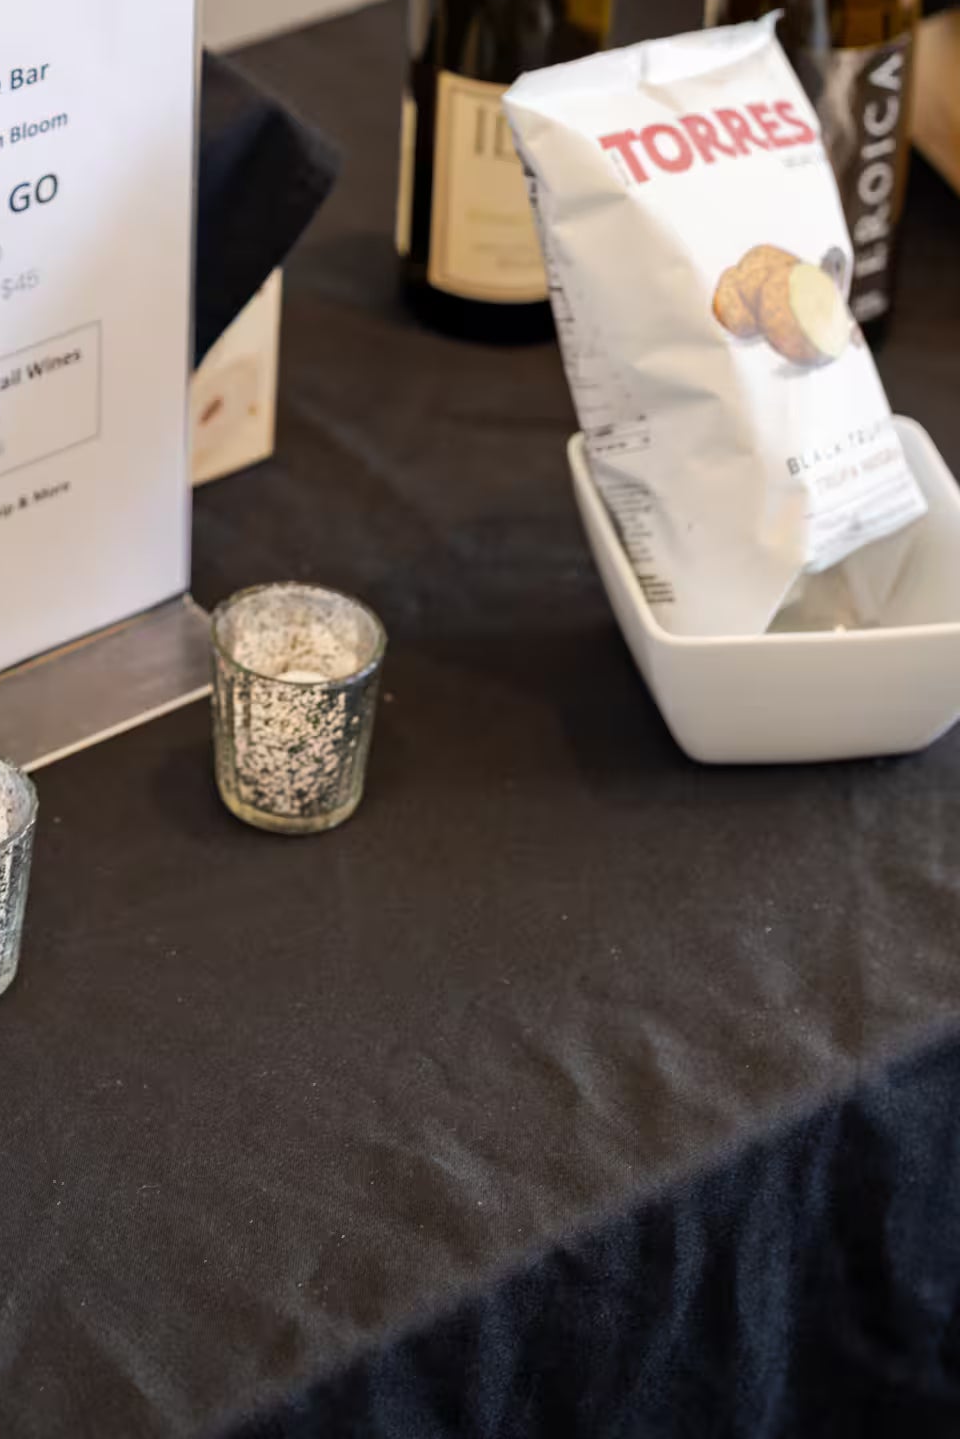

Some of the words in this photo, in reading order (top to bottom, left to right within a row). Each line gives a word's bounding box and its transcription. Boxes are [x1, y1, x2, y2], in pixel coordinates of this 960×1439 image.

[10, 62, 50, 90] Bar
[9, 111, 68, 144] Bloom
[597, 99, 817, 185] TORRES
[9, 173, 59, 213] GO
[0, 269, 41, 301] $45
[26, 347, 83, 381] Wines
